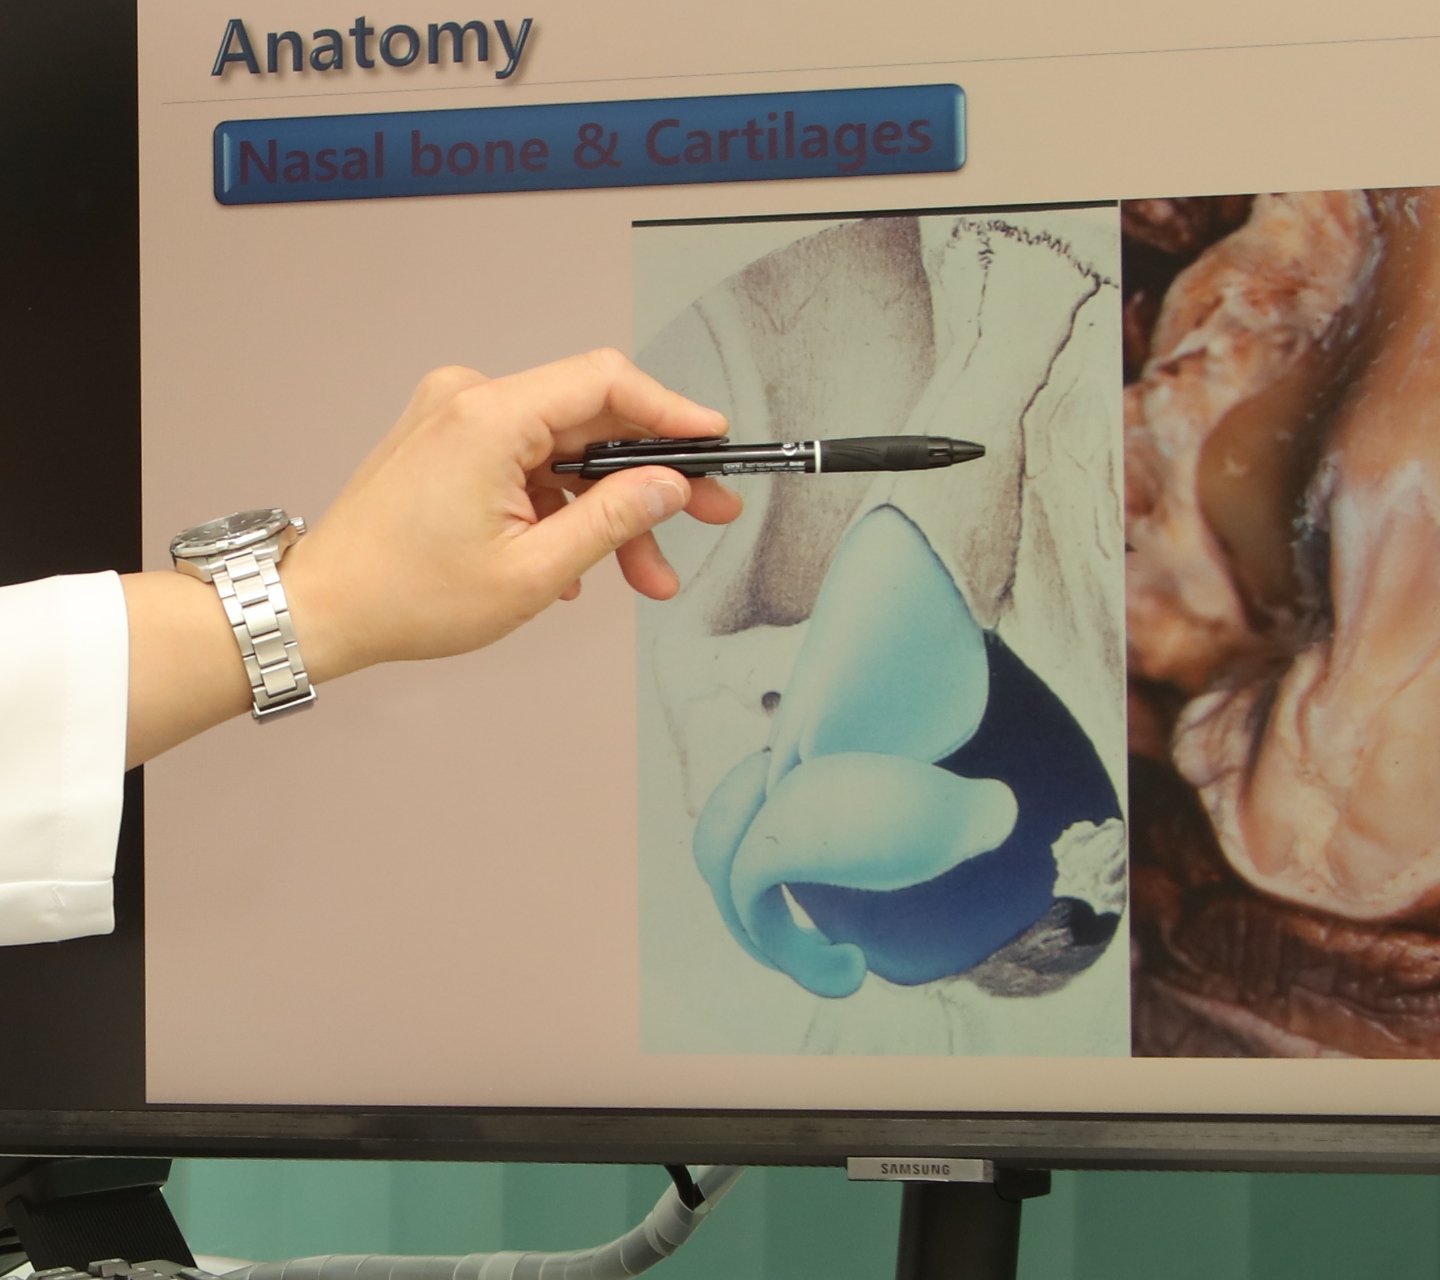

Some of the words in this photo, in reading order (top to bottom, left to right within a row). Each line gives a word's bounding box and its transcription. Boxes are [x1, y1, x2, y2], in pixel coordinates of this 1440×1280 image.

[210, 16, 534, 81] Anatomy
[238, 131, 385, 185] Nasal
[411, 129, 550, 178] bone
[572, 122, 622, 170] &
[645, 111, 934, 171] Cartilages
[880, 1163, 951, 1176] SAMSUNG
